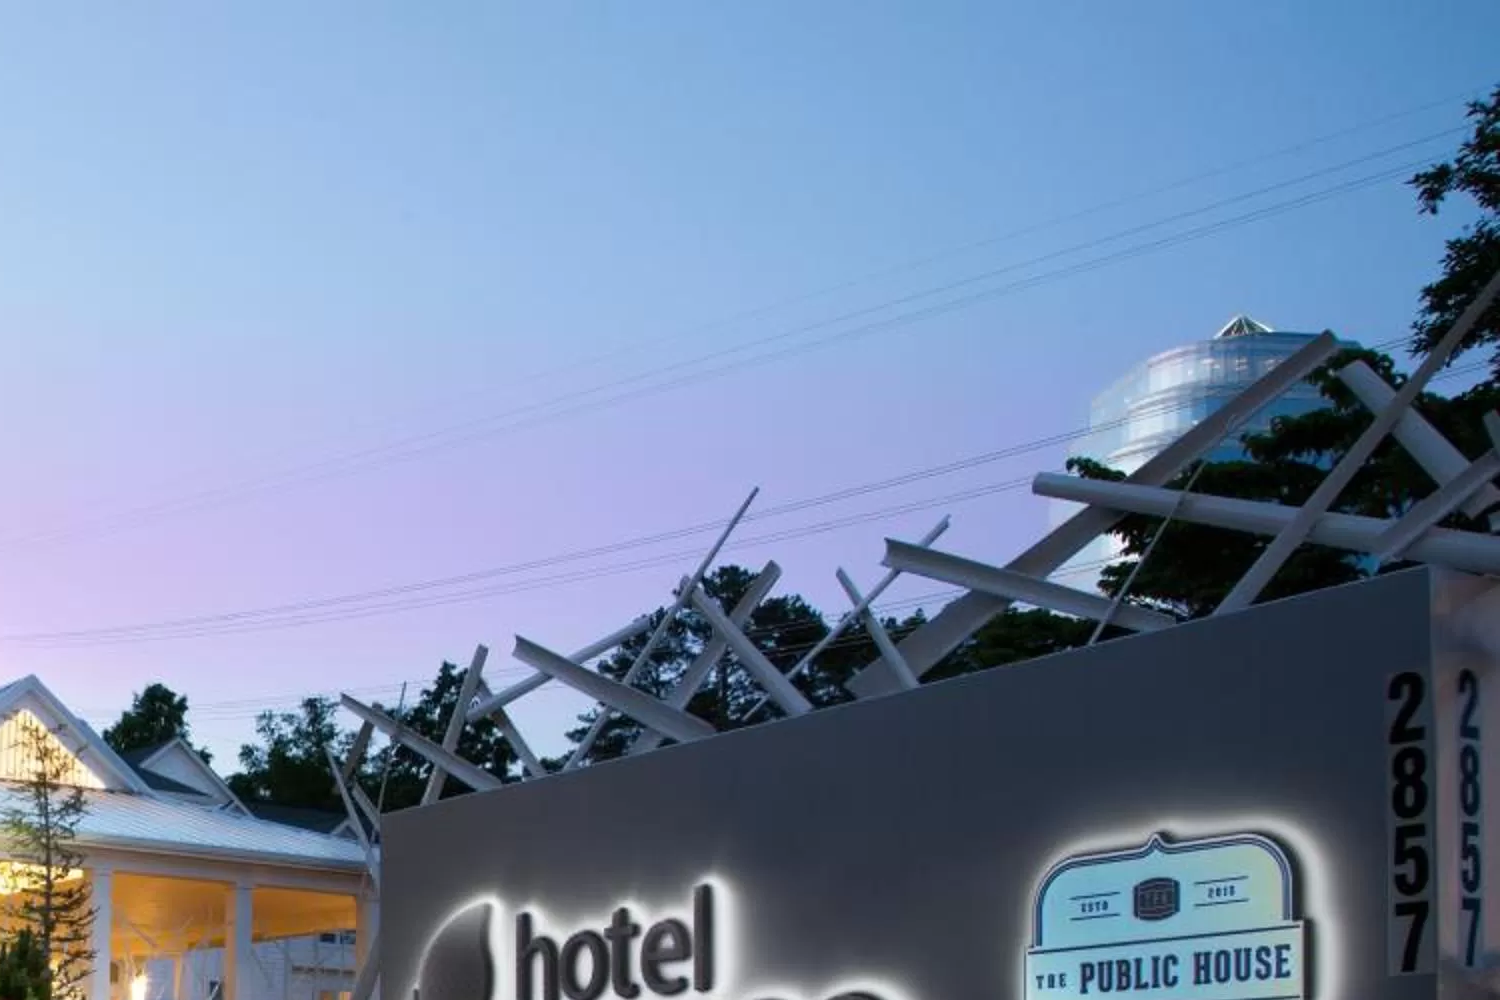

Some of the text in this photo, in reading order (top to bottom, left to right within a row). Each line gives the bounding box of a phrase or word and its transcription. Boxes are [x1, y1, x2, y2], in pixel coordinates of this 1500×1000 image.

[1387, 671, 1429, 973] 2857
[1457, 668, 1481, 967] 2857
[1035, 944, 1291, 994] THE PUBLIC HOUSE
